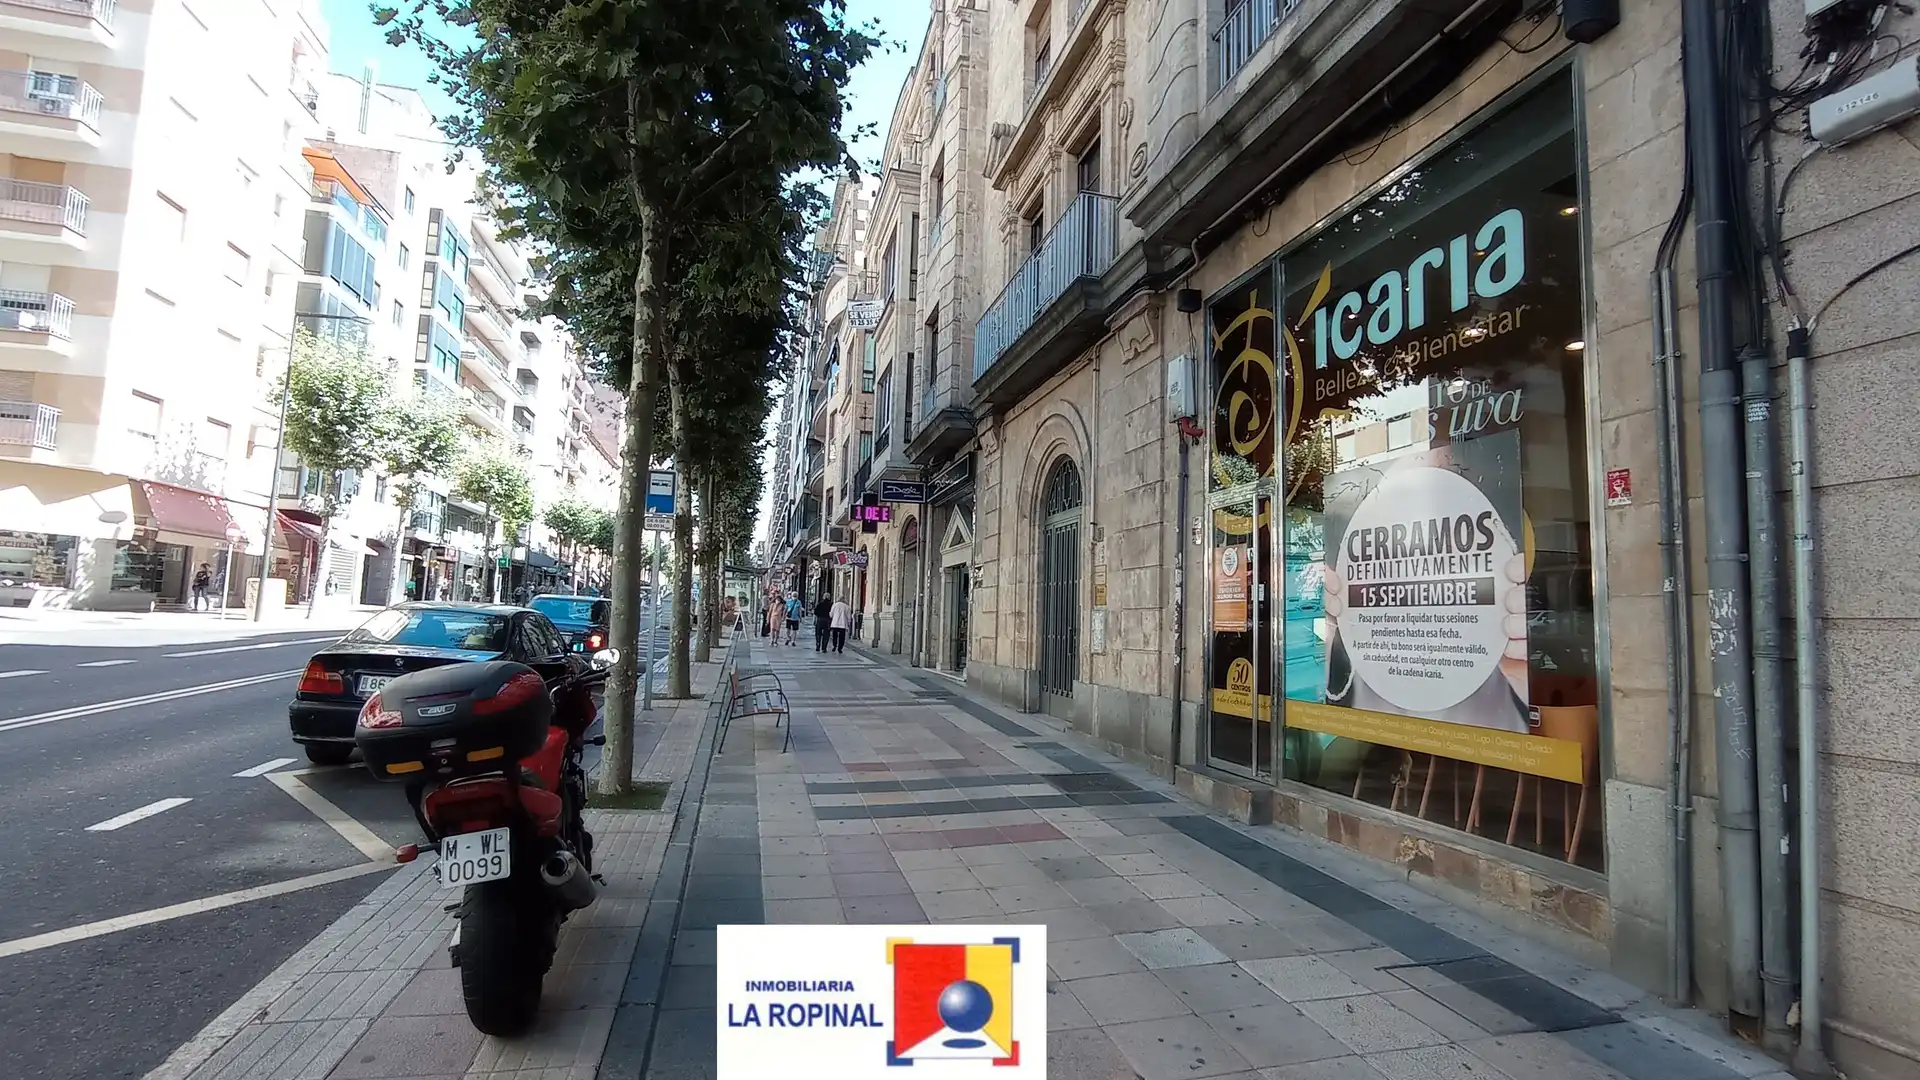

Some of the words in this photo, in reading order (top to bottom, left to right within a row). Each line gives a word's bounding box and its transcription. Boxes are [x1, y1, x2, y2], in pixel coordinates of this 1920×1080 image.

[1407, 304, 1528, 368] Bienestar
[1470, 379, 1493, 399] DE
[1449, 388, 1525, 437] uva
[1347, 511, 1495, 563] CERRAMOS
[1347, 553, 1494, 581] DEFINITIVAMENTE
[1360, 587, 1376, 607] 15
[1380, 581, 1477, 606] SEPTIEMBRE
[1358, 613, 1372, 623] Pasa
[1373, 615, 1383, 625] por
[1384, 612, 1400, 623] favor
[1400, 615, 1405, 623] a
[1406, 612, 1433, 625] liquidar
[1434, 614, 1446, 623] tus
[1446, 612, 1479, 624] sesiones
[1371, 627, 1406, 639] pendientes
[1406, 627, 1425, 638] hasta
[1426, 629, 1437, 638] esa
[1439, 627, 1462, 639] fecha.
[1353, 640, 1357, 649] A
[1357, 640, 1371, 650] partir
[1372, 641, 1379, 650] de
[1391, 642, 1397, 650] tu
[1398, 641, 1413, 651] bono
[1427, 643, 1464, 654] igualmente
[1388, 666, 1395, 675] de
[1396, 666, 1401, 675] la
[1402, 667, 1423, 678] cadena
[1409, 656, 1437, 667] cualquier
[1437, 658, 1451, 667] otro
[1452, 659, 1474, 668] centro
[1231, 683, 1251, 693] CENTROS
[446, 840, 458, 861] M
[481, 833, 505, 855] WL
[449, 855, 502, 883] 0099
